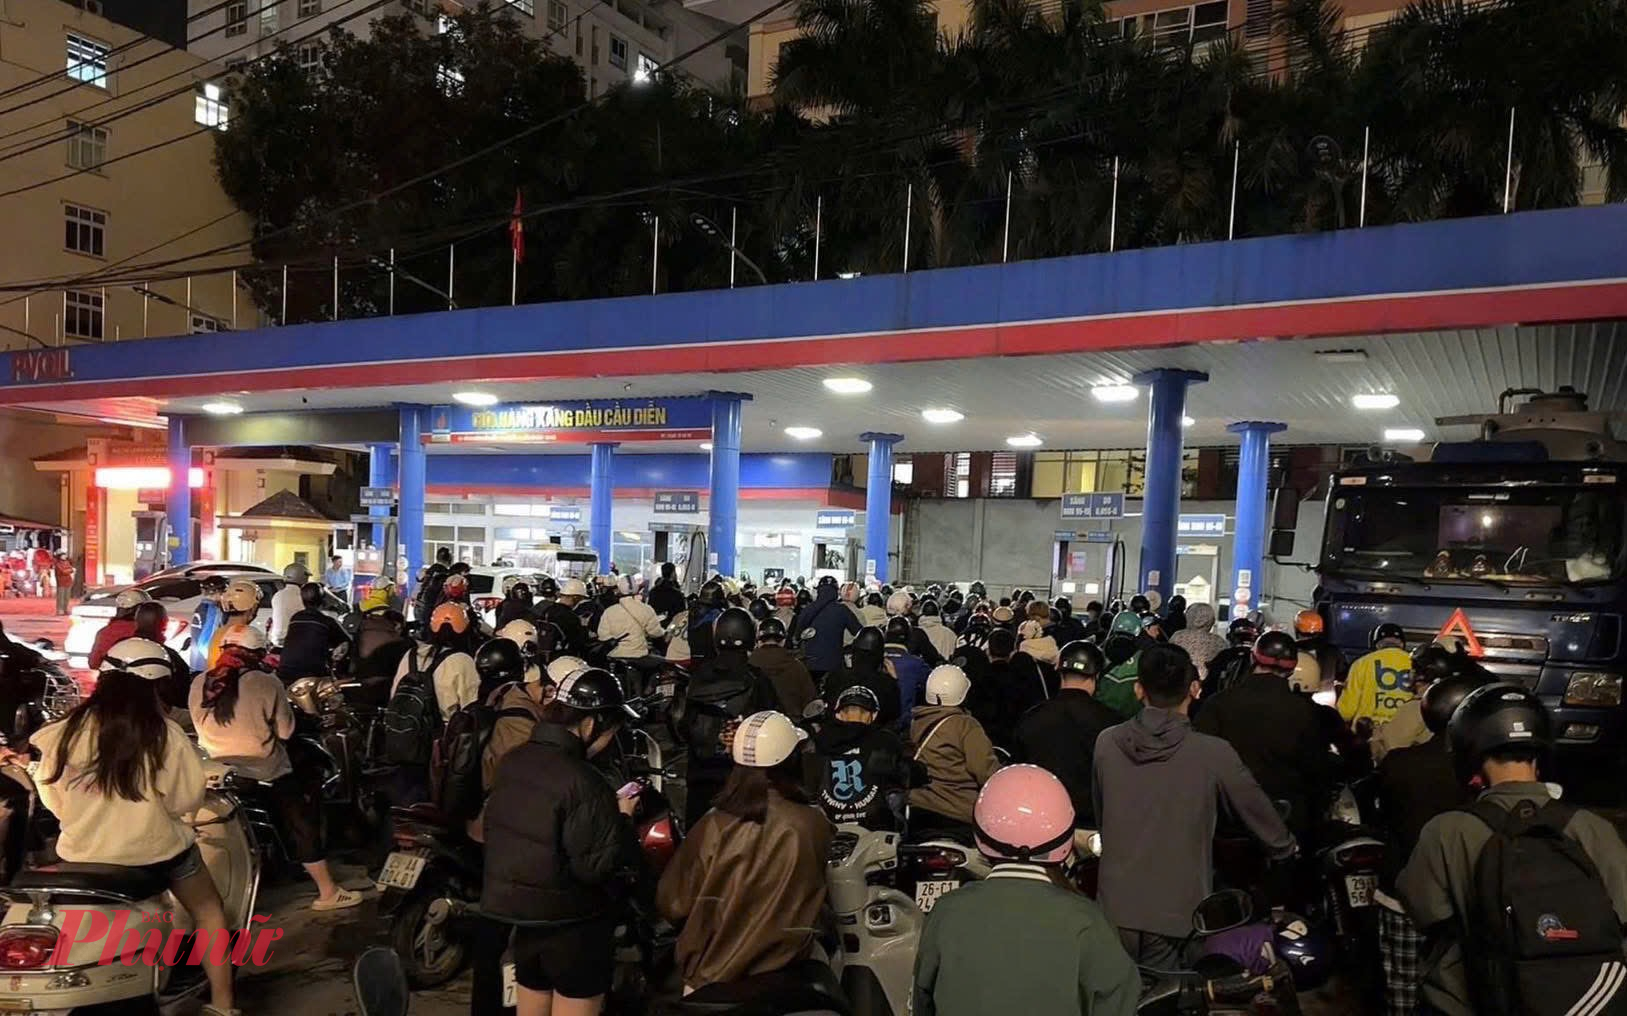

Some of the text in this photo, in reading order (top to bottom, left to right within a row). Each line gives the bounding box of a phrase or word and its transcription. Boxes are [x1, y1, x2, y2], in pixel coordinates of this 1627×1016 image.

[575, 402, 602, 427] DẦU
[604, 401, 632, 426] CẦU
[634, 400, 666, 425] DIỄN
[831, 760, 867, 800] R
